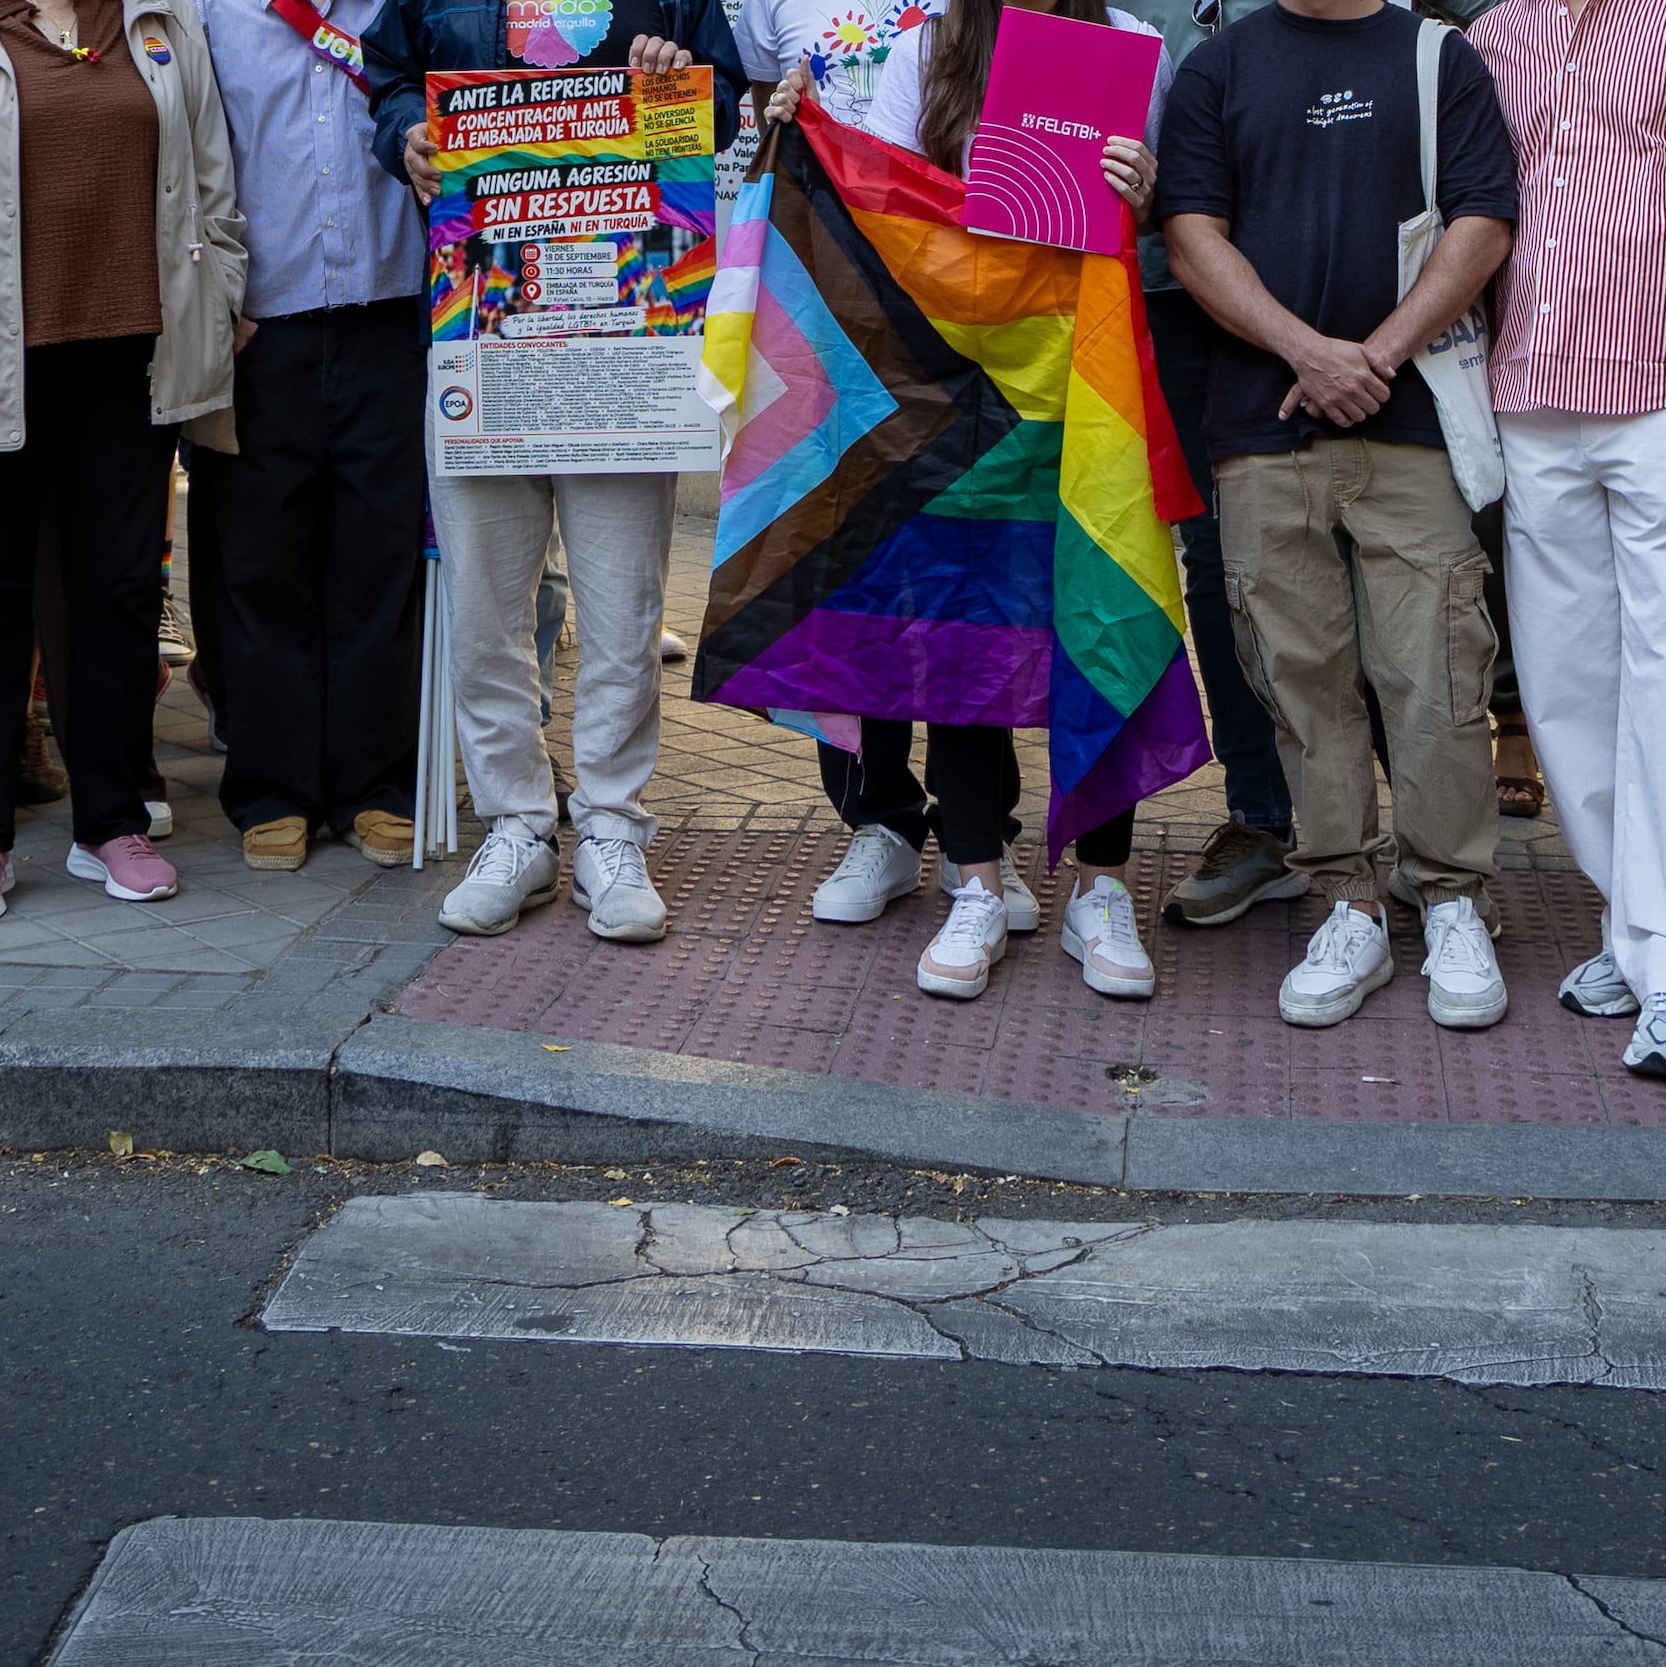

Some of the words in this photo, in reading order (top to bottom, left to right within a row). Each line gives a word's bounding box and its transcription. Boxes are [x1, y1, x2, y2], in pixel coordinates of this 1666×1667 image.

[507, 18, 551, 29] madrid
[554, 17, 596, 30] orgullo
[313, 26, 362, 67] UGT
[448, 86, 497, 112] ANTE
[501, 82, 524, 105] LA
[530, 70, 625, 102] REPRESIÓN
[447, 133, 465, 150] LA
[469, 126, 542, 149] EMBAJADA
[546, 123, 565, 141] DE
[569, 112, 629, 140] TURQUÍA
[457, 101, 578, 131] CONCENTRACIÓN
[582, 99, 620, 119] ANTE
[1036, 116, 1102, 140] FELGTBI+
[476, 168, 561, 196] NINGUNA
[566, 161, 651, 187] AGRESIÓN
[484, 196, 521, 224] SIN
[527, 186, 651, 219] RESPUESTA
[445, 399, 467, 408] EPOA
